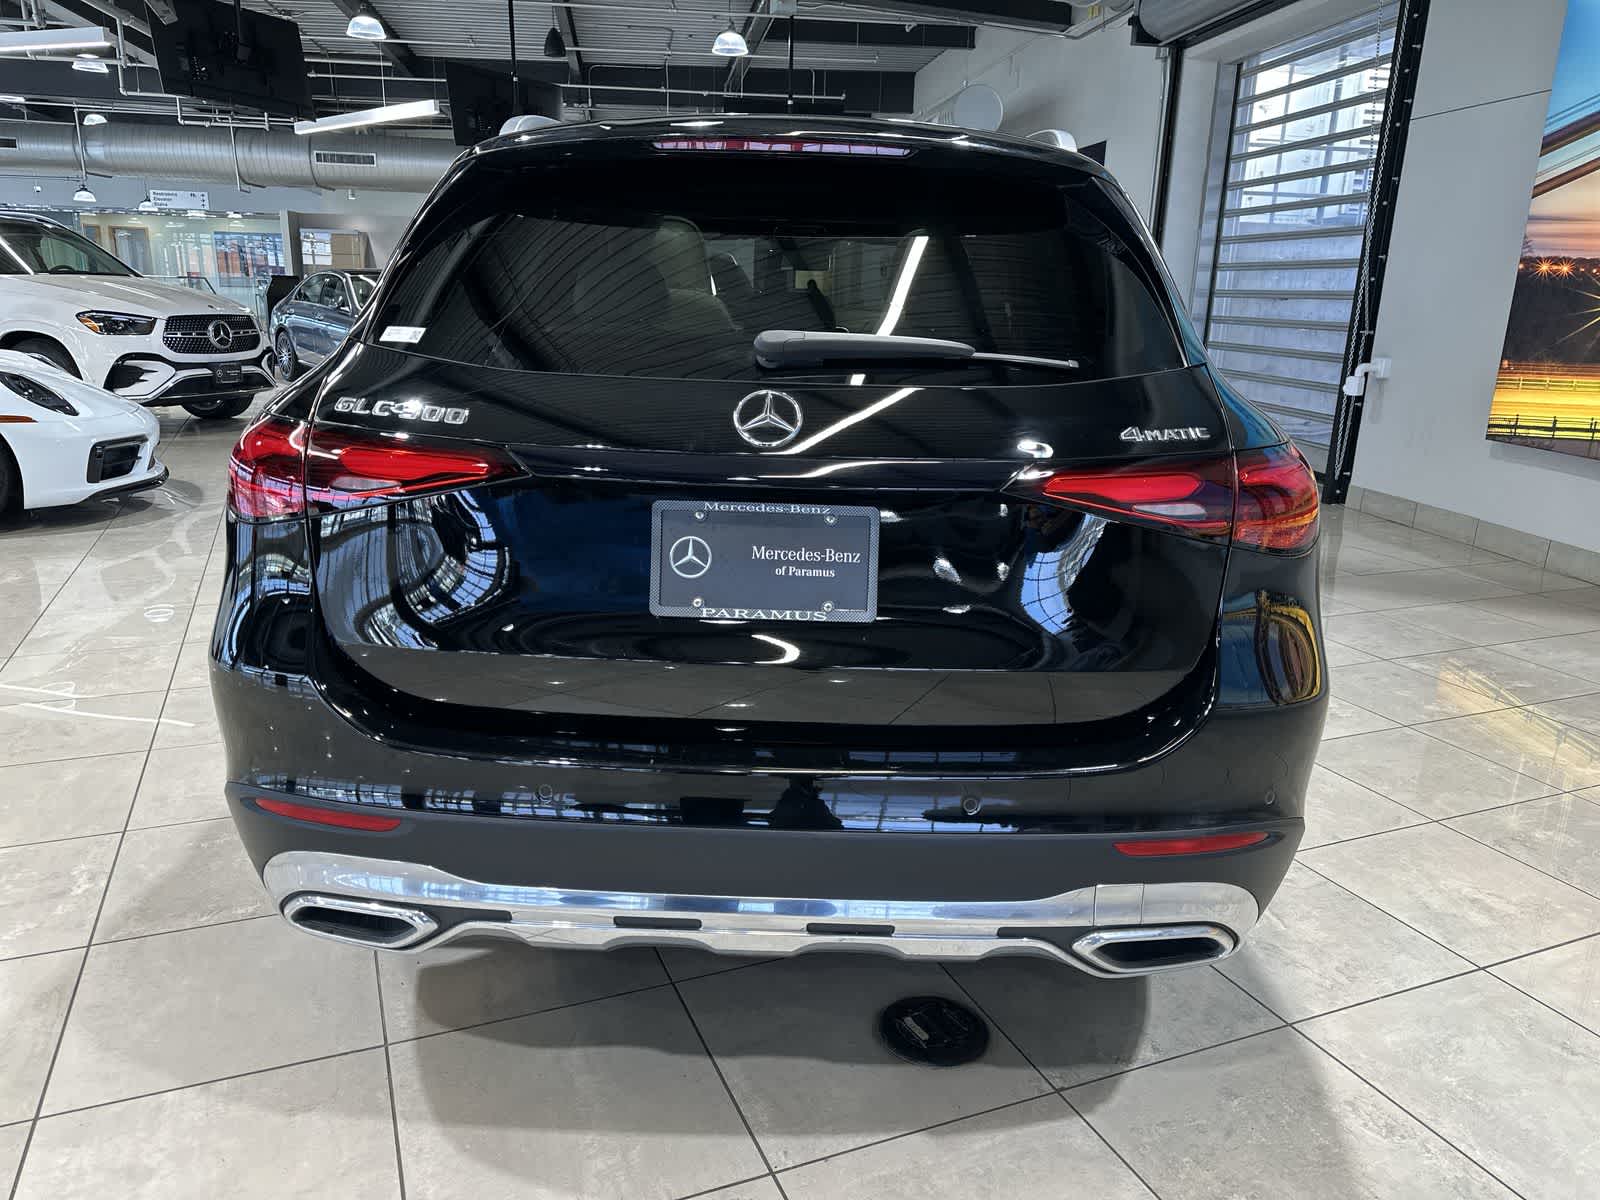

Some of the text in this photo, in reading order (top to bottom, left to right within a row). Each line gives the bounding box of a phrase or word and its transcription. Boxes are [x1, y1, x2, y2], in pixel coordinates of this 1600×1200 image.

[1119, 426, 1211, 442] 4MATIC
[703, 501, 832, 515] Mercedes-Benz
[751, 545, 861, 564] Mercedes-Benz
[775, 566, 836, 578] of Paramus
[701, 607, 828, 622] PARAMUS
